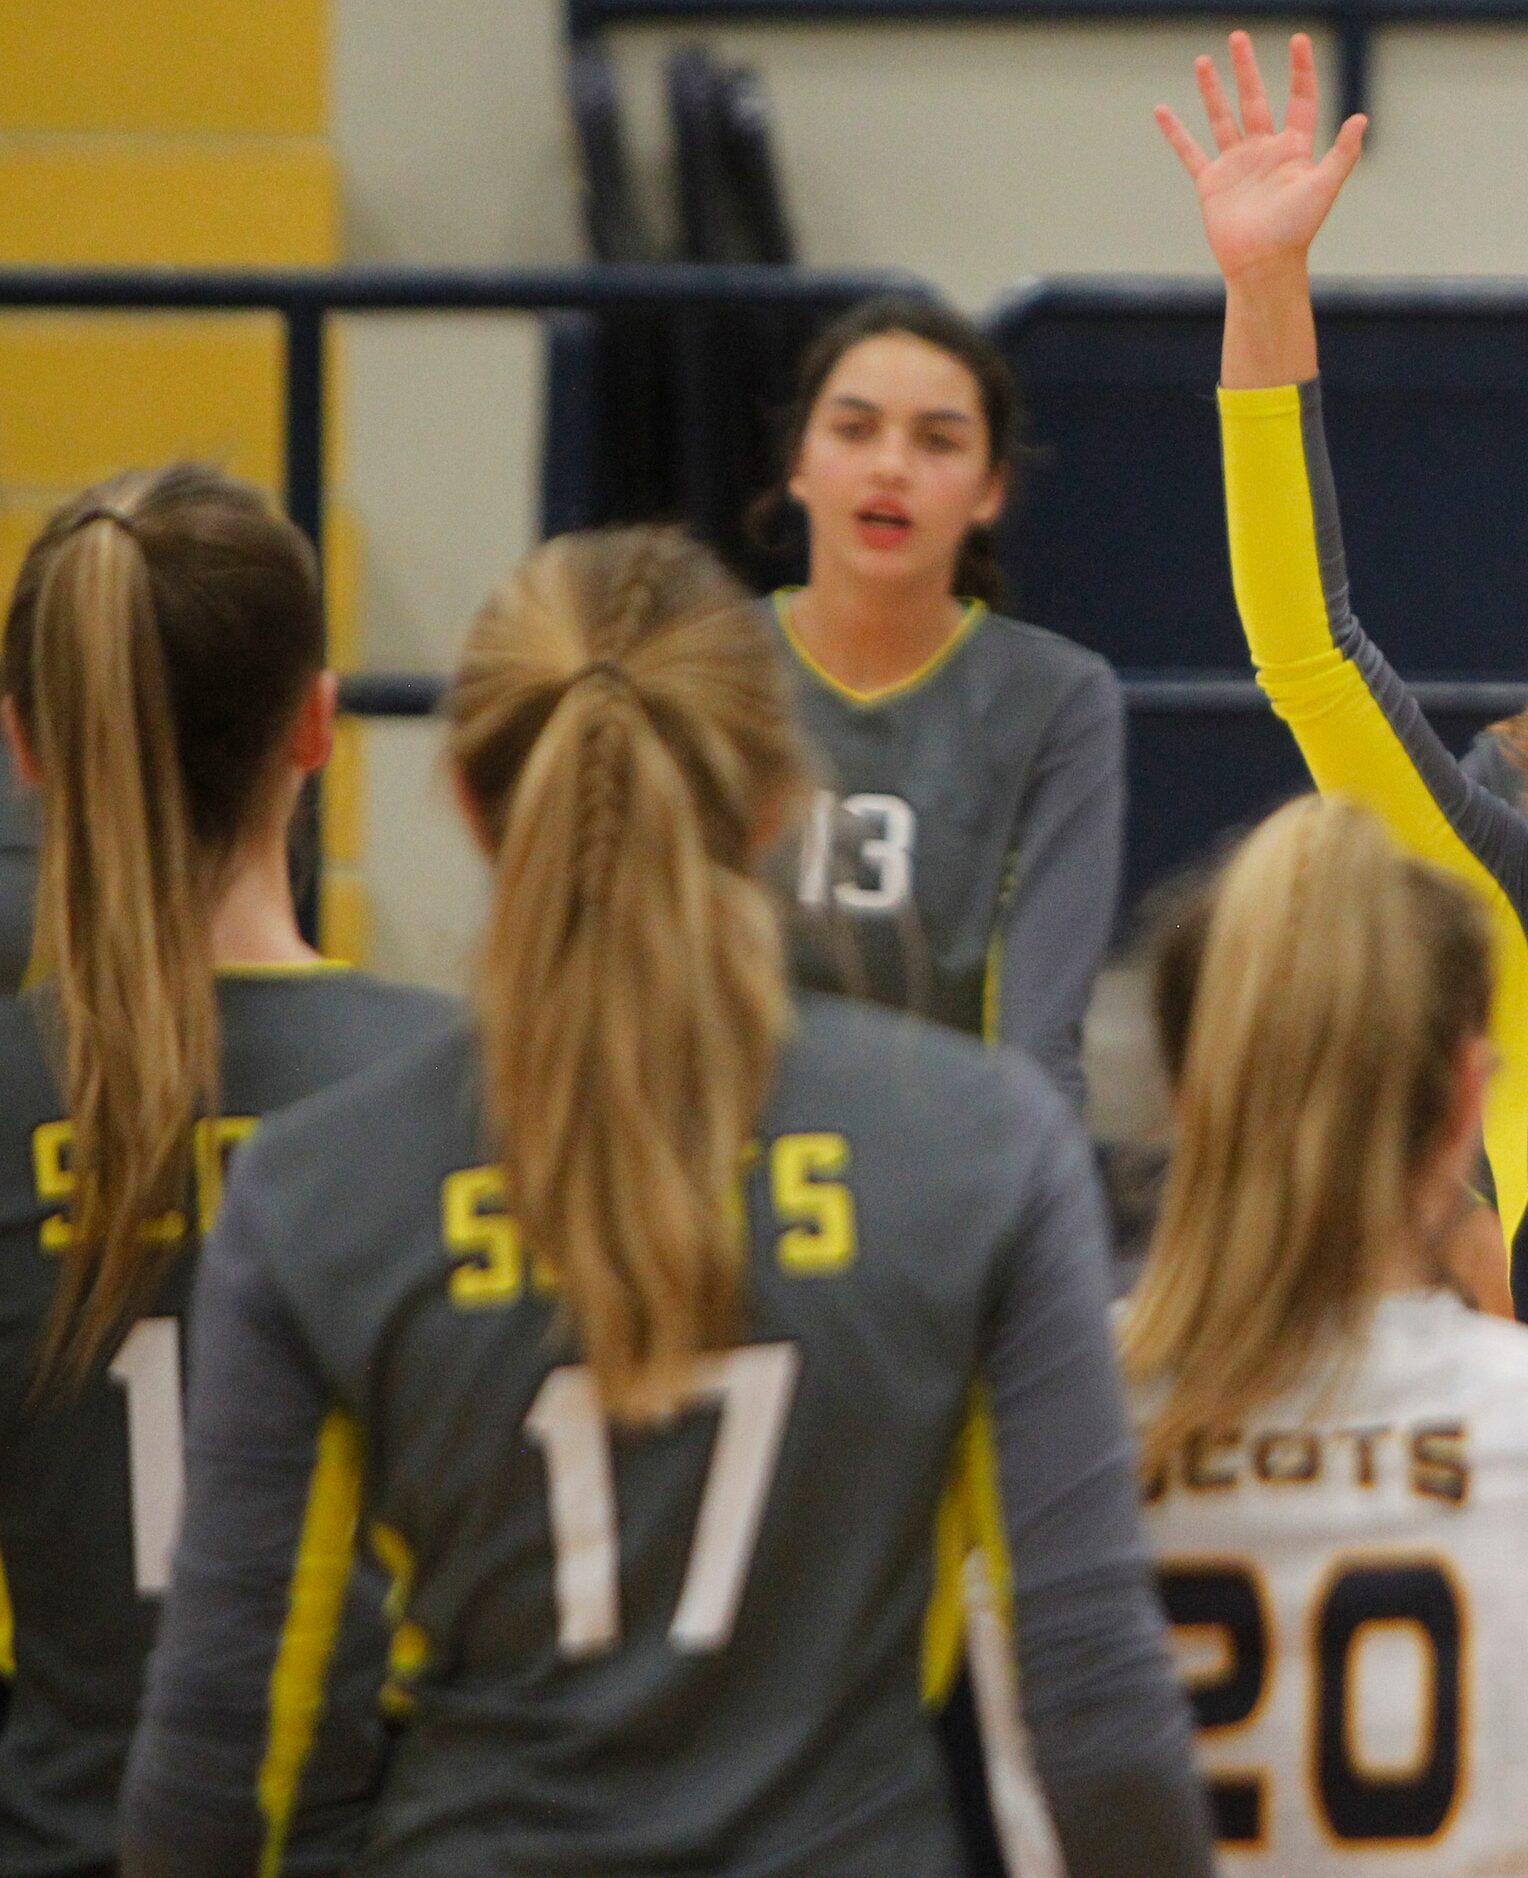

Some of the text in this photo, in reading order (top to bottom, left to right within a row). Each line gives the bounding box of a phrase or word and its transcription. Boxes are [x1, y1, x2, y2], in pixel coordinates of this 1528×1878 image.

[798, 788, 916, 908] 13
[523, 1341, 800, 1658] 17
[1141, 1418, 1472, 1508] COTS
[1152, 1552, 1474, 1852] 20
